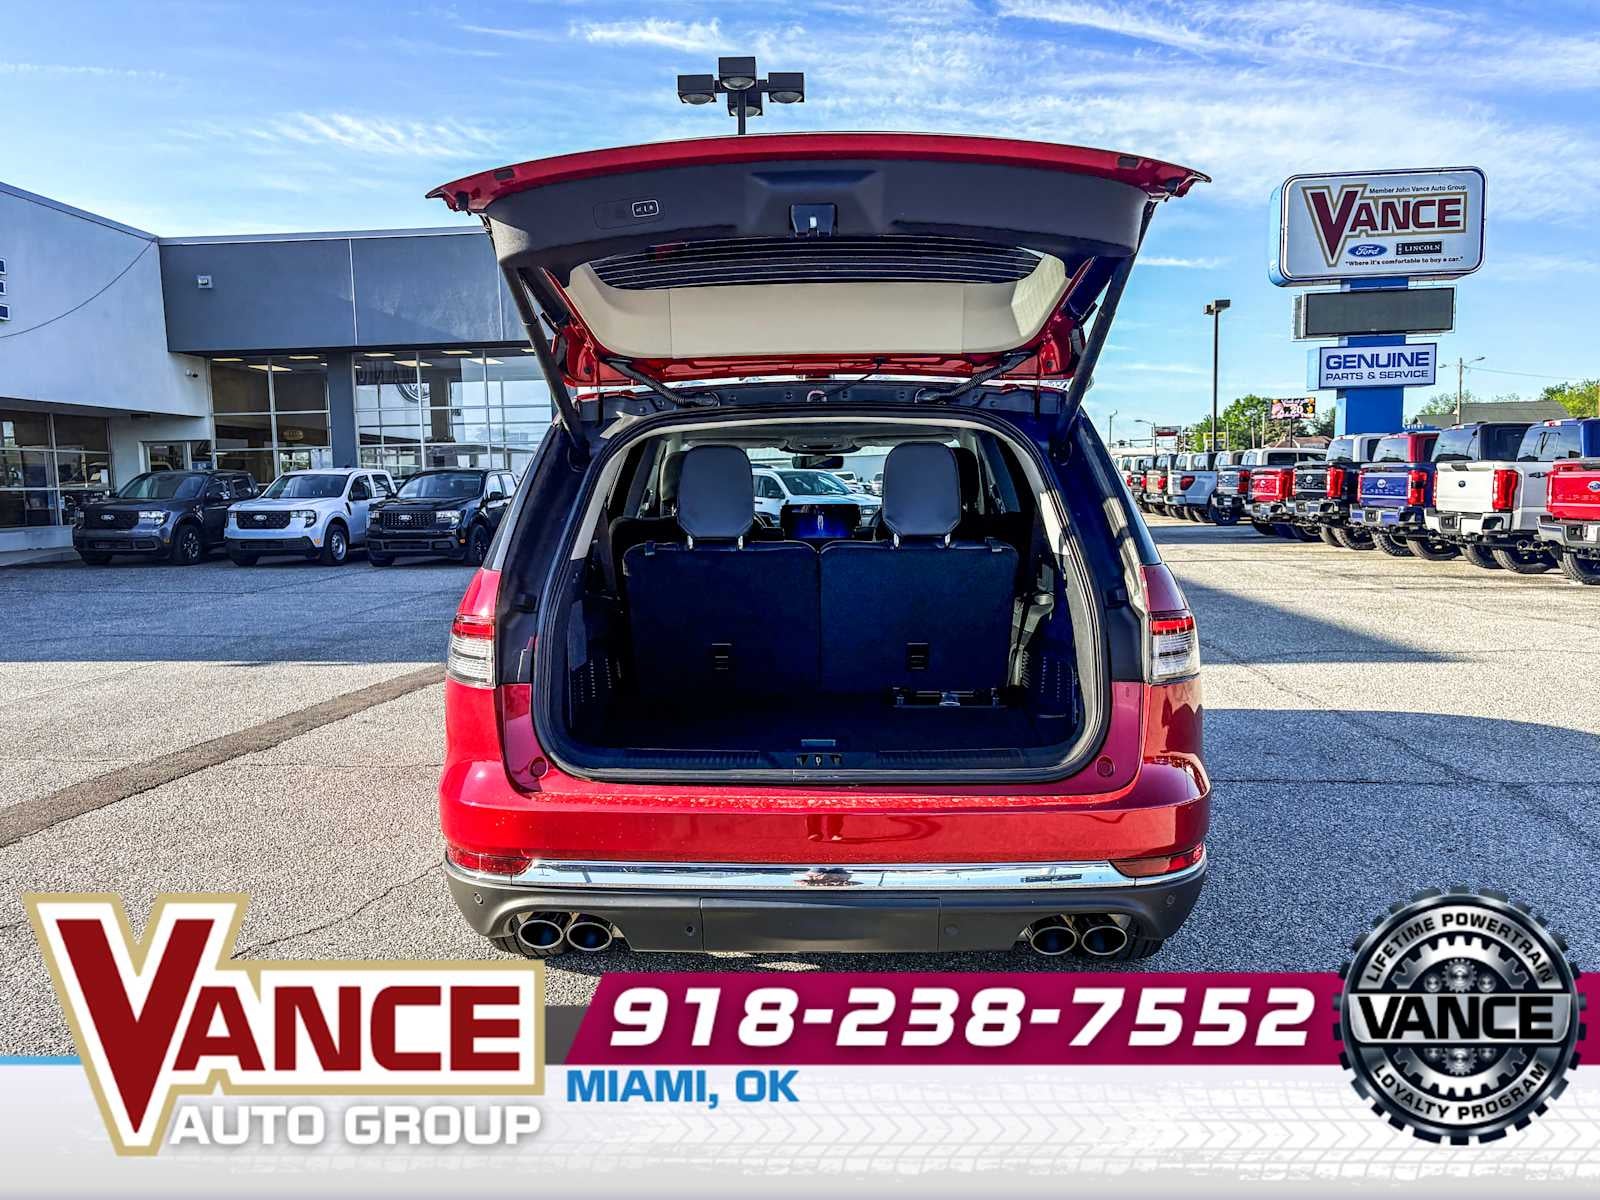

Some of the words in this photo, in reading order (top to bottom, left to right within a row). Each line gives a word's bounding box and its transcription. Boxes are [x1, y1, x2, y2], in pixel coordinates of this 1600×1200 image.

[1310, 190, 1462, 260] VANCE
[1404, 243, 1441, 252] LINCOLN
[1326, 352, 1430, 370] GENUINE
[1325, 372, 1364, 381] PARTS
[1367, 371, 1376, 380] &
[1379, 369, 1429, 379] SERVICE
